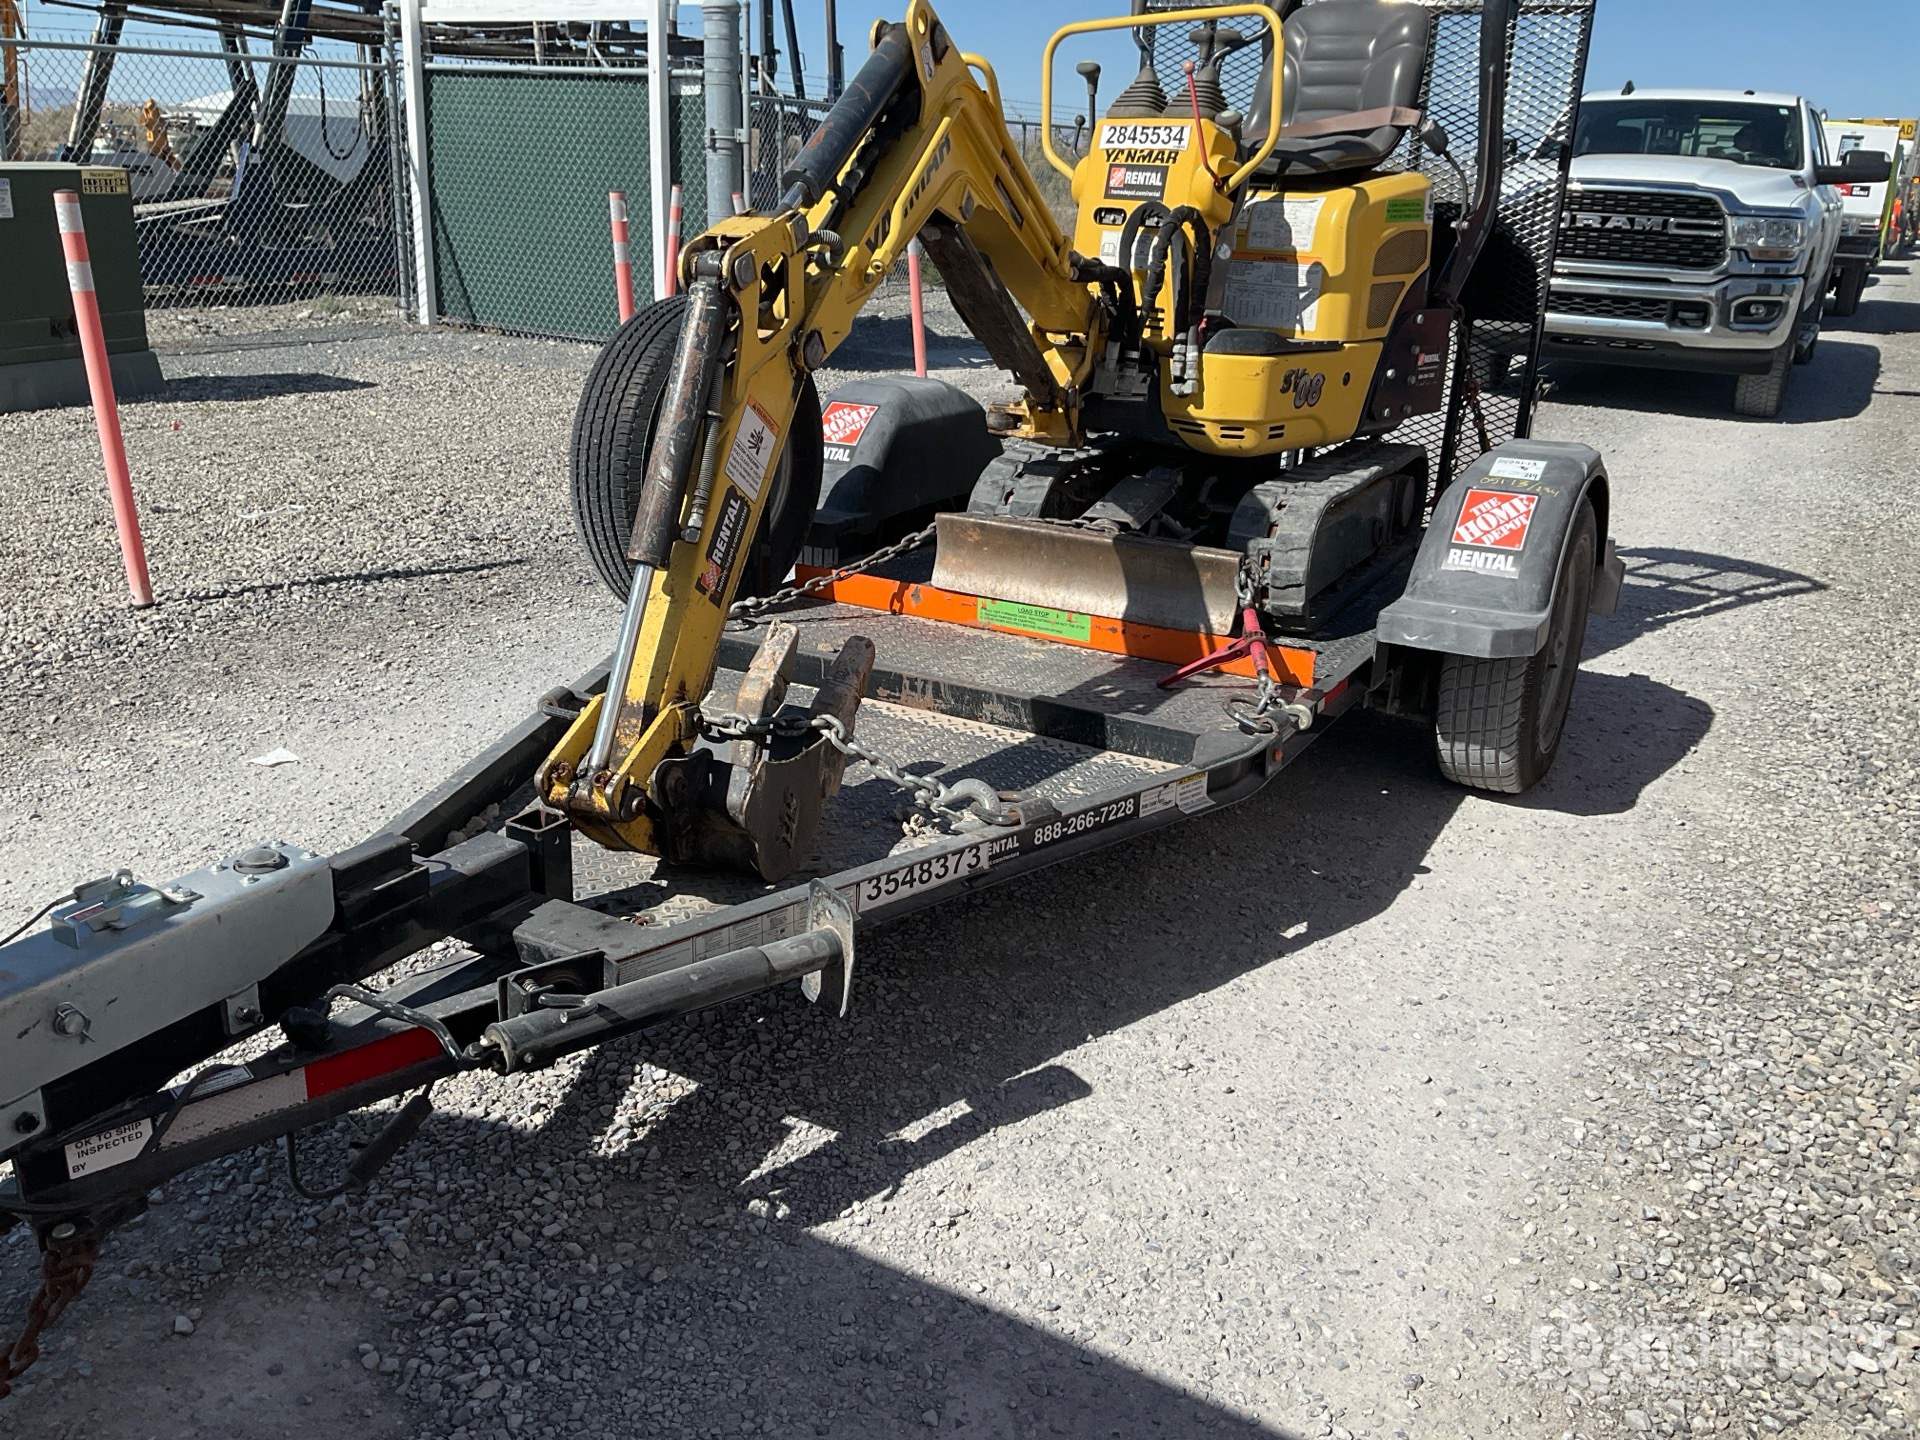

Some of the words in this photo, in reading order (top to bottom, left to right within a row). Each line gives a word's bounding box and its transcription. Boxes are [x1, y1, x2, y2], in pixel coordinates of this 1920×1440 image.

[1106, 126, 1184, 145] 2845534
[1899, 124, 1914, 135] AD
[1105, 149, 1179, 164] YANMAR
[1124, 171, 1162, 186] RENTAL
[1576, 214, 1664, 231] RAM
[828, 407, 851, 421] THE
[831, 419, 867, 441] DEPOT
[823, 446, 850, 461] NTAL
[1469, 497, 1502, 517] THE
[1456, 495, 1534, 544] HOME
[712, 499, 740, 566] RENTAL
[1481, 514, 1530, 546] DEPOT
[1447, 548, 1516, 572] RENTAL
[1034, 609, 1050, 618] STOP
[1034, 798, 1134, 845] 888-266-7228
[989, 835, 1019, 856] ENTAL
[866, 845, 981, 900] 3548373
[75, 1136, 92, 1149] OK
[97, 1131, 112, 1144] TO
[115, 1121, 142, 1136] SHIP
[77, 1131, 143, 1159] INSPECTED
[72, 1162, 87, 1174] BY
